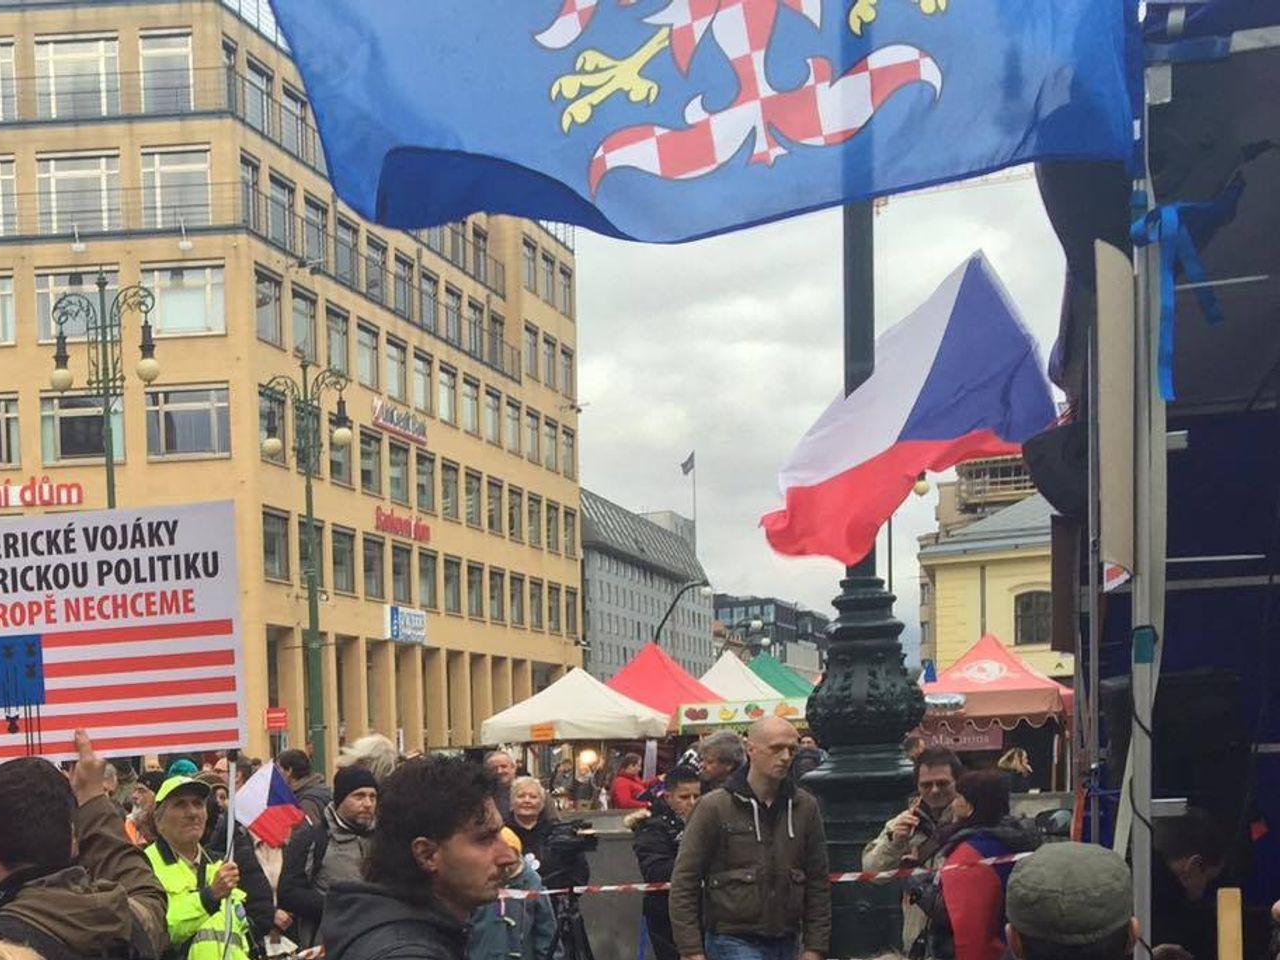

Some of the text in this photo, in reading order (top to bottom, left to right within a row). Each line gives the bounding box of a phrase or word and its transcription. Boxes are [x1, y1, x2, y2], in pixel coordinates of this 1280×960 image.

[20, 475, 84, 507] dům
[82, 518, 180, 553] VOJÁKY
[96, 550, 220, 587] POLITIKU
[64, 588, 196, 626] NECHCEME
